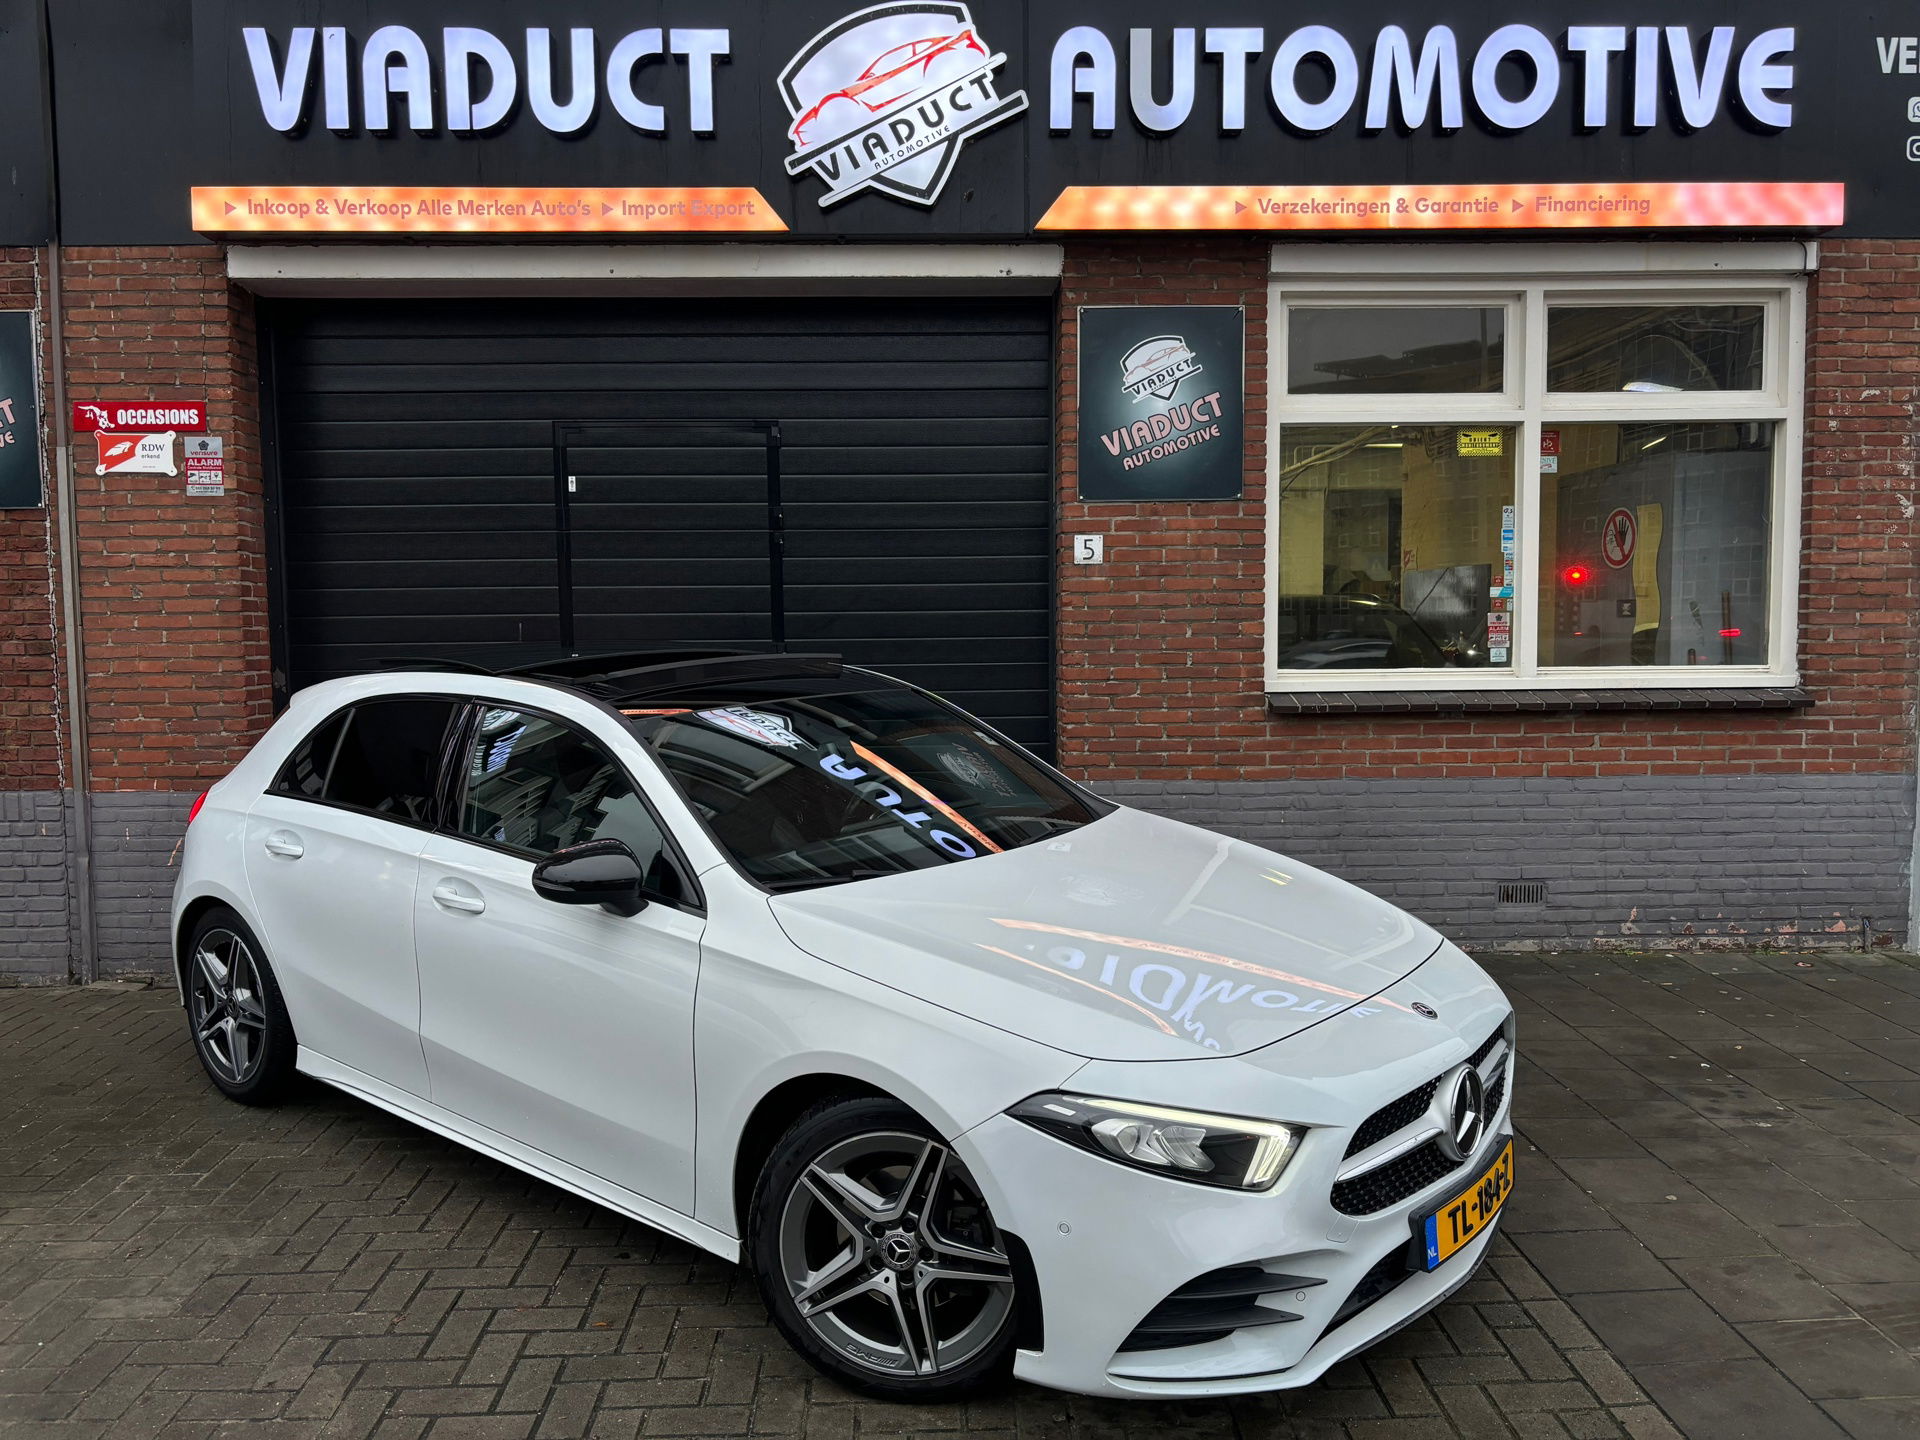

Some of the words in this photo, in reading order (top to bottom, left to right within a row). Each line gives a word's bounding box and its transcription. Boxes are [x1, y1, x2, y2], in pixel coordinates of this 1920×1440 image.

[1876, 37, 1920, 73] VE
[242, 25, 731, 133] VIADUCT
[1050, 24, 1796, 132] AUTOMOTIVE
[815, 73, 993, 181] VIADUCT
[874, 124, 951, 170] AUTOMOTIVE
[248, 199, 310, 218] Inkoop
[316, 198, 329, 215] &
[334, 199, 412, 219] Verkoop
[417, 199, 452, 215] Alle
[458, 199, 526, 216] Merken
[531, 199, 591, 216] Auto's
[622, 199, 686, 219] Import
[691, 199, 756, 219] Export
[1258, 197, 1390, 217] Verzekeringen
[1395, 197, 1409, 214] &
[1415, 196, 1499, 214] Garantie
[1536, 195, 1651, 215] Financiering
[1132, 358, 1191, 395] VIADUCT
[0, 398, 16, 427] T
[116, 408, 199, 425] OCCASIONS
[1100, 391, 1223, 456] VIADUCT
[141, 443, 165, 452] RDW
[188, 458, 222, 466] ALARM
[1122, 424, 1221, 471] AUTOMOTIVE
[1083, 539, 1095, 560] 5
[1448, 1152, 1511, 1244] TL-184-Z
[1428, 1246, 1438, 1259] NL
